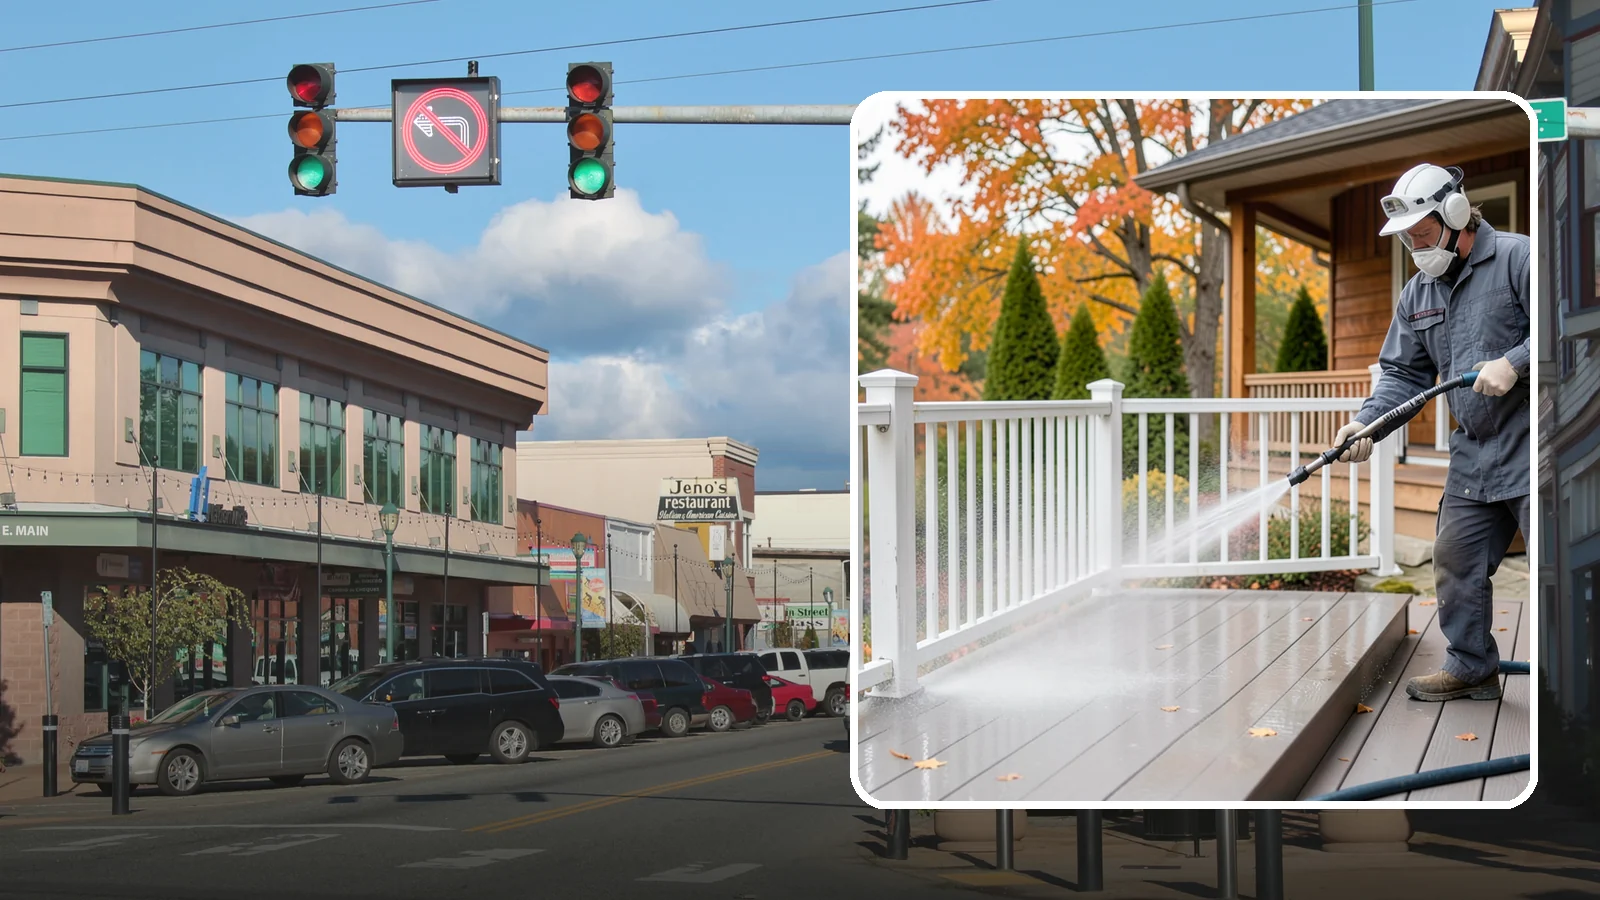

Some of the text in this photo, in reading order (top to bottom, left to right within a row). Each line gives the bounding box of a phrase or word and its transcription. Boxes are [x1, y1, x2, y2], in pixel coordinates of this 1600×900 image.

[669, 480, 728, 495] Jeno's
[665, 496, 731, 509] restaurant
[658, 510, 681, 520] Italian
[686, 510, 714, 519] American
[715, 509, 738, 519] Cuisine
[2, 525, 49, 536] E. MAIN
[797, 608, 828, 616] Street
